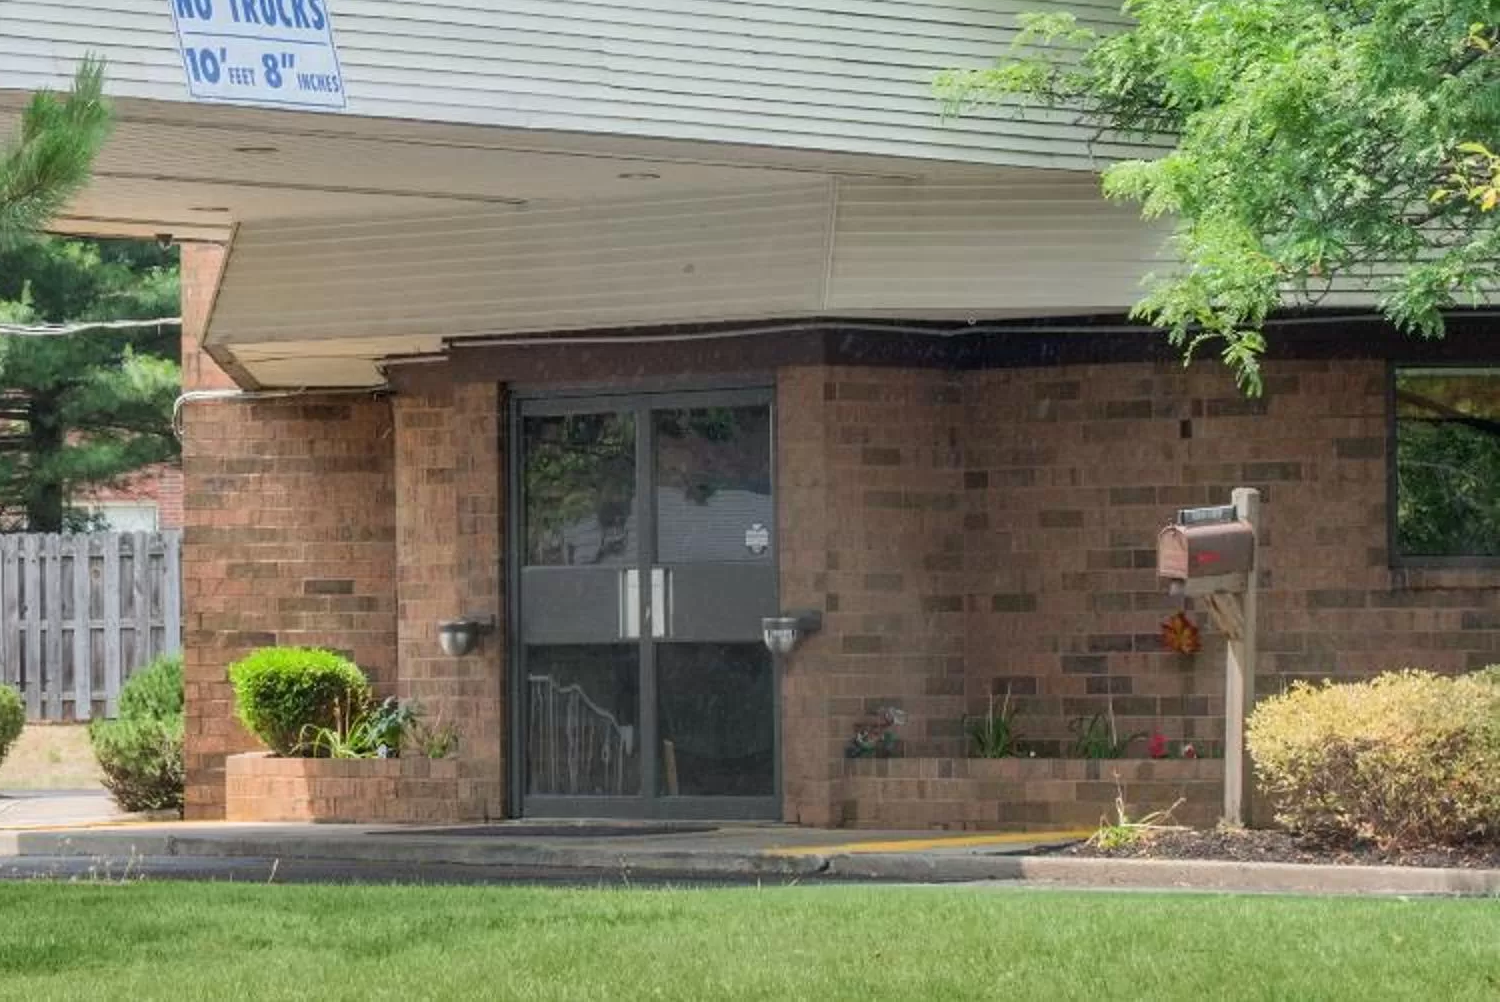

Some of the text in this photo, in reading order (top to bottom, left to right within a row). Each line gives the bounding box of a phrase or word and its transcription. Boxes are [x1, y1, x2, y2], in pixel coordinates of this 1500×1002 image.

[185, 47, 340, 93] 10' FEET 8" INCHES
